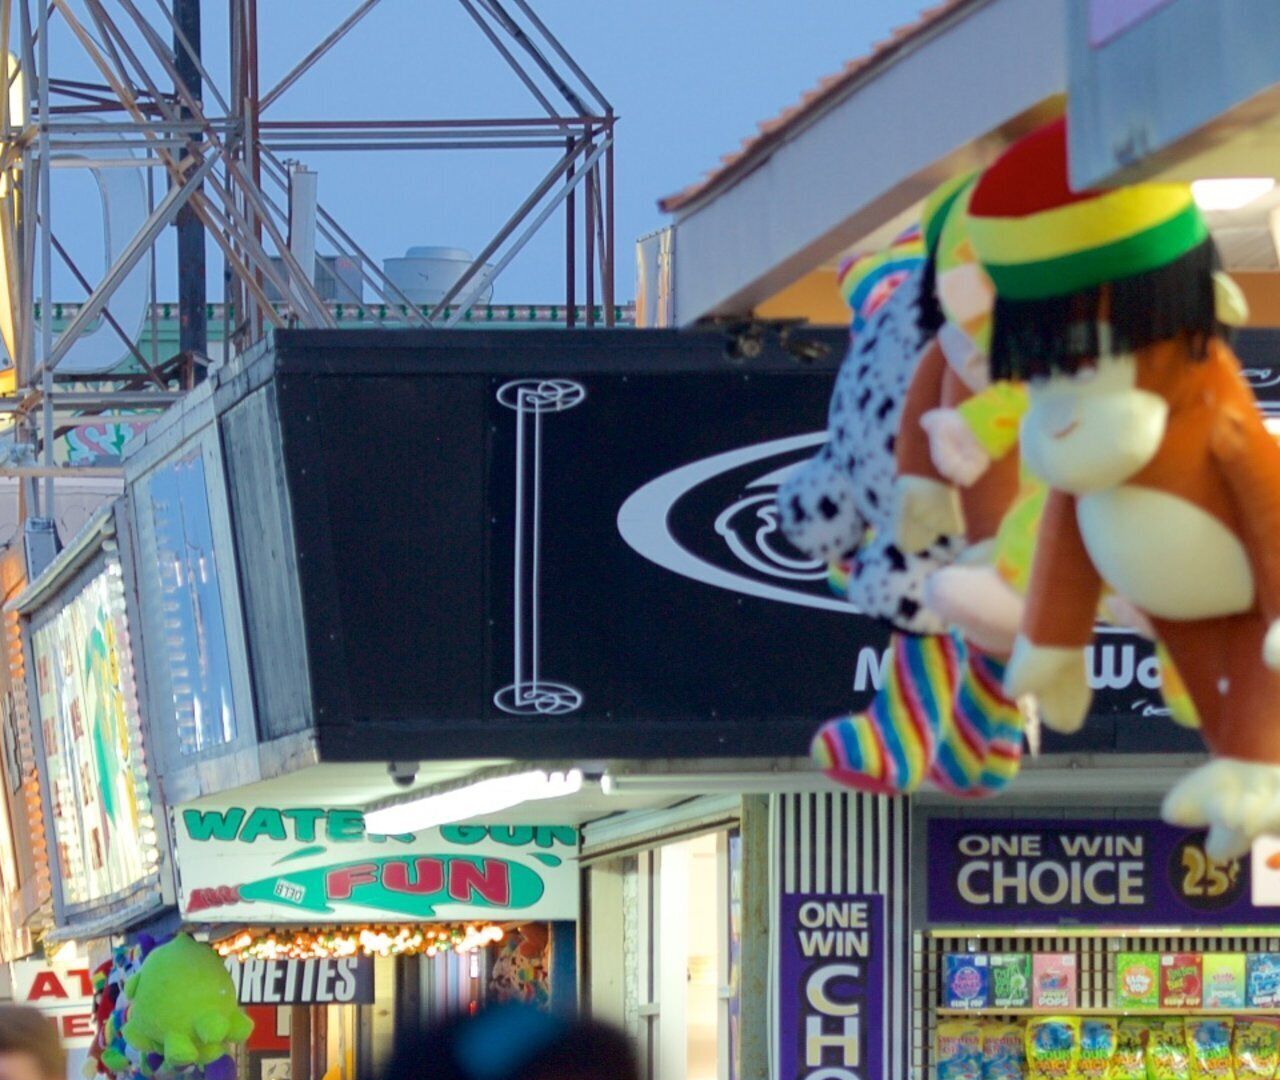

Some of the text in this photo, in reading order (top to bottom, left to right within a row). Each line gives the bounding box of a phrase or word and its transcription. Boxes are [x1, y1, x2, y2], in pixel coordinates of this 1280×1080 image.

[441, 823, 577, 847] GUN
[957, 835, 1144, 857] ONE WIN
[325, 857, 511, 906] FUN
[956, 862, 1145, 906] CHOICE
[798, 901, 868, 929] ONE
[798, 931, 869, 957] WIN
